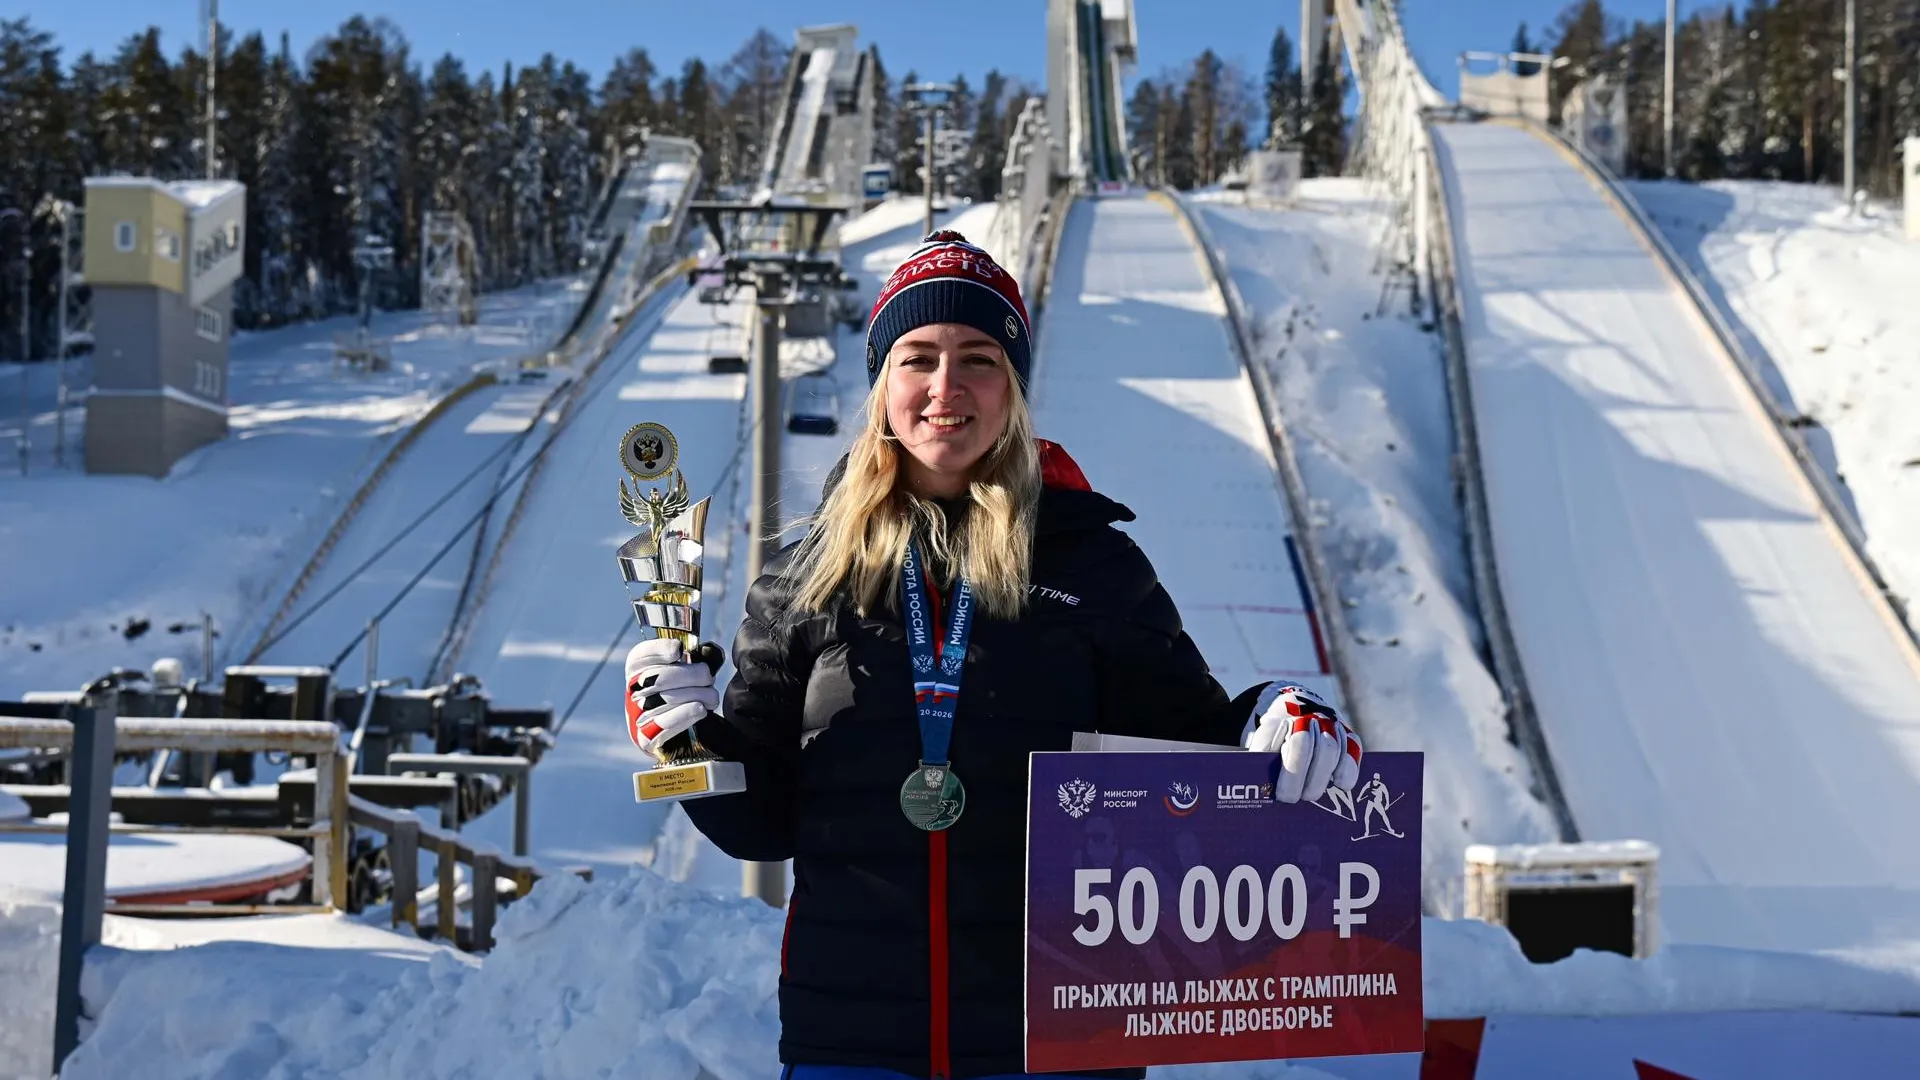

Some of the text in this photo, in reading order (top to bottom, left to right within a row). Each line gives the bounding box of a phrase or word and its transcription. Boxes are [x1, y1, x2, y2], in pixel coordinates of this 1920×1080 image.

[1040, 586, 1081, 606] TIME
[908, 593, 926, 645] РОССИИ
[932, 710, 953, 719] 2026
[1103, 790, 1148, 798] МИНСПОРТ
[1217, 785, 1260, 800] ЦСП
[1103, 800, 1137, 808] РОССИИ
[1072, 866, 1160, 947] 50
[1179, 863, 1308, 943] 000
[1053, 973, 1398, 1010] ПРЫЖКИ НА ЛЫЖАХ С ТРАМПЛИНА
[1124, 1005, 1333, 1037] ЛЫЖНОЕ ДВОЕБОРЬЕ
